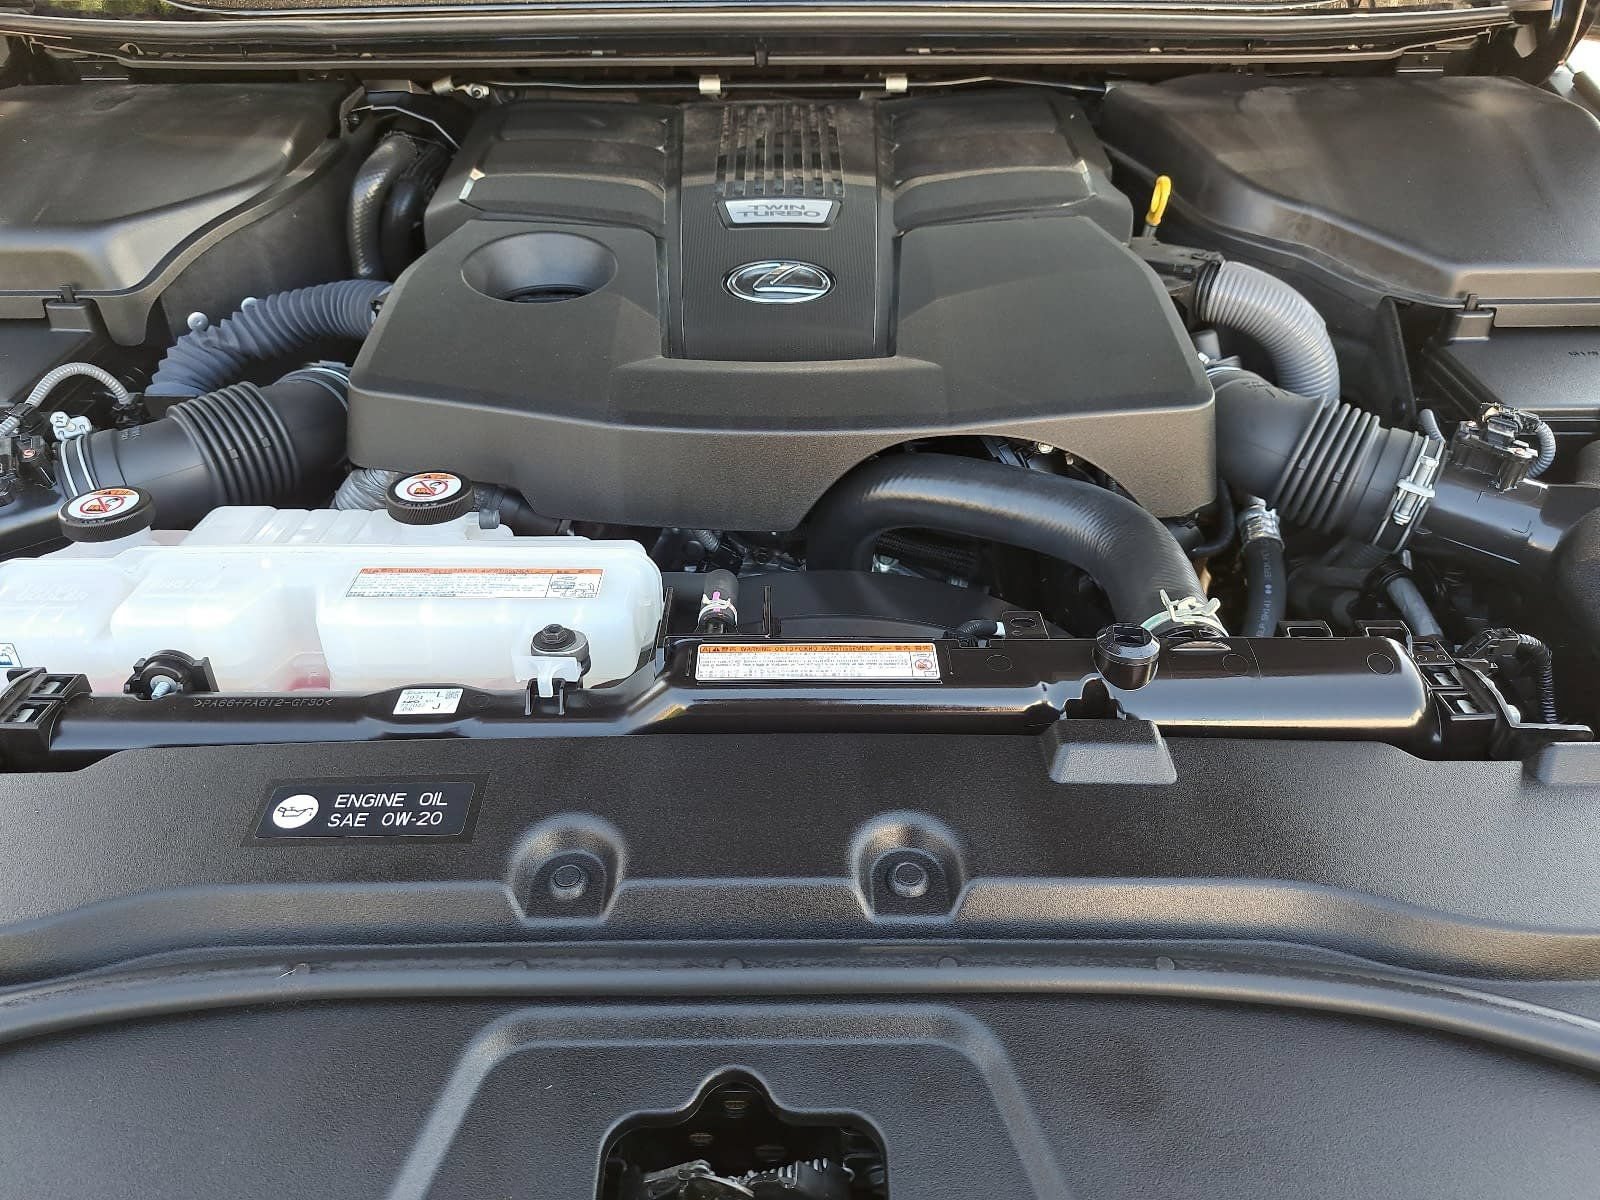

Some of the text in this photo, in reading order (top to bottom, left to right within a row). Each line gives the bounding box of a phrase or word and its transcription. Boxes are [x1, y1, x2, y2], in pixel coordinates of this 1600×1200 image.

[735, 210, 821, 218] TURBO
[334, 791, 448, 809] ENGINE OIL
[327, 811, 443, 828] SAE 0W-20
